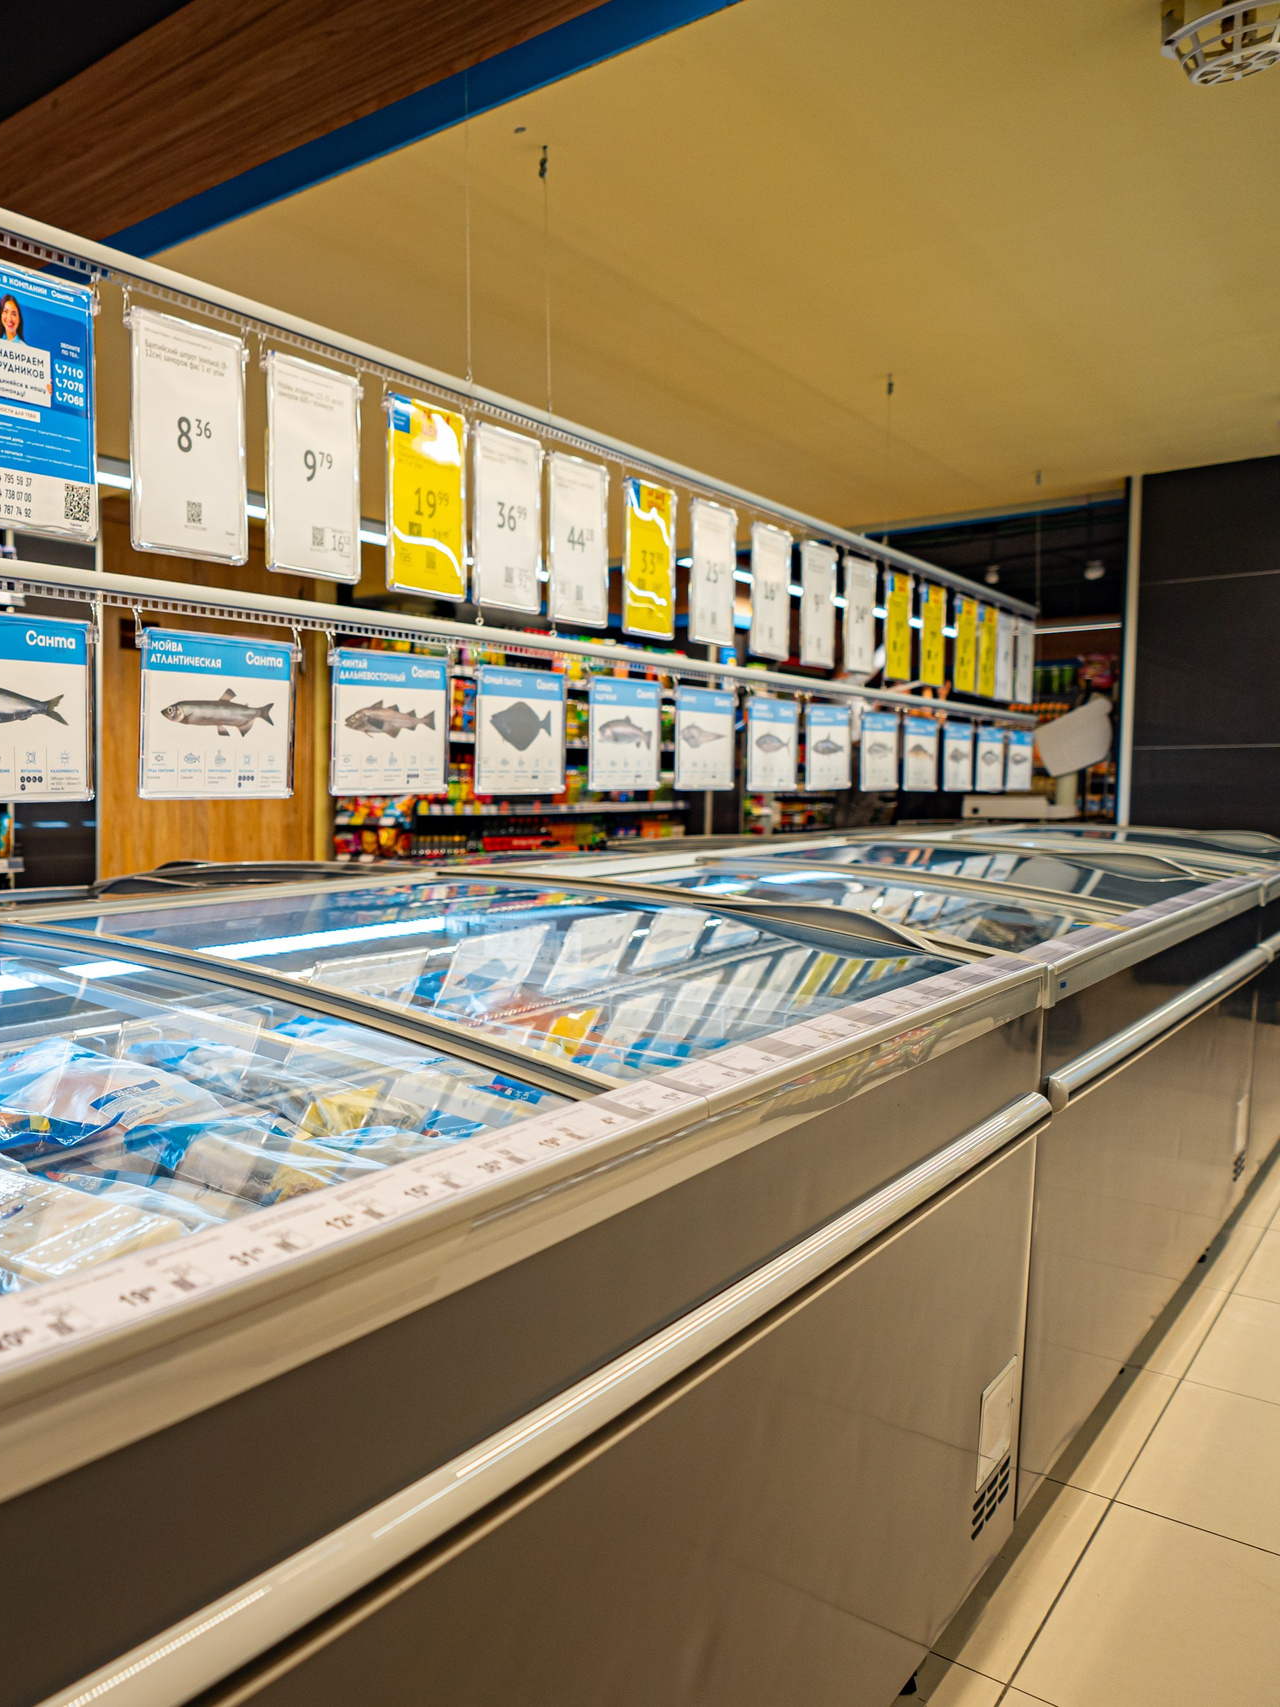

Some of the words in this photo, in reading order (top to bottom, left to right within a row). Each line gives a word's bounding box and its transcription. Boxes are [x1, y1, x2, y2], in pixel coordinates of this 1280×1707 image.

[9, 277, 47, 295] КОМПАНИИ
[51, 290, 74, 302] Санта
[62, 365, 83, 379] 7110
[63, 379, 84, 393] 7078
[63, 393, 84, 407] 7068
[4, 473, 14, 484] 795
[26, 477, 32, 487] 37
[5, 489, 15, 500] 738
[17, 491, 23, 501] 07
[24, 493, 32, 503] 00
[4, 504, 14, 515] 787
[25, 508, 32, 518] 92
[26, 630, 76, 649] Санта
[151, 640, 183, 652] МОЙВА
[150, 653, 222, 668] АТЛАНТИЧЕСКАЯ
[246, 652, 283, 667] Санта
[340, 670, 406, 682] ДАЛЬНЕВОСТОЧНЫЙ
[411, 666, 440, 680] Санта
